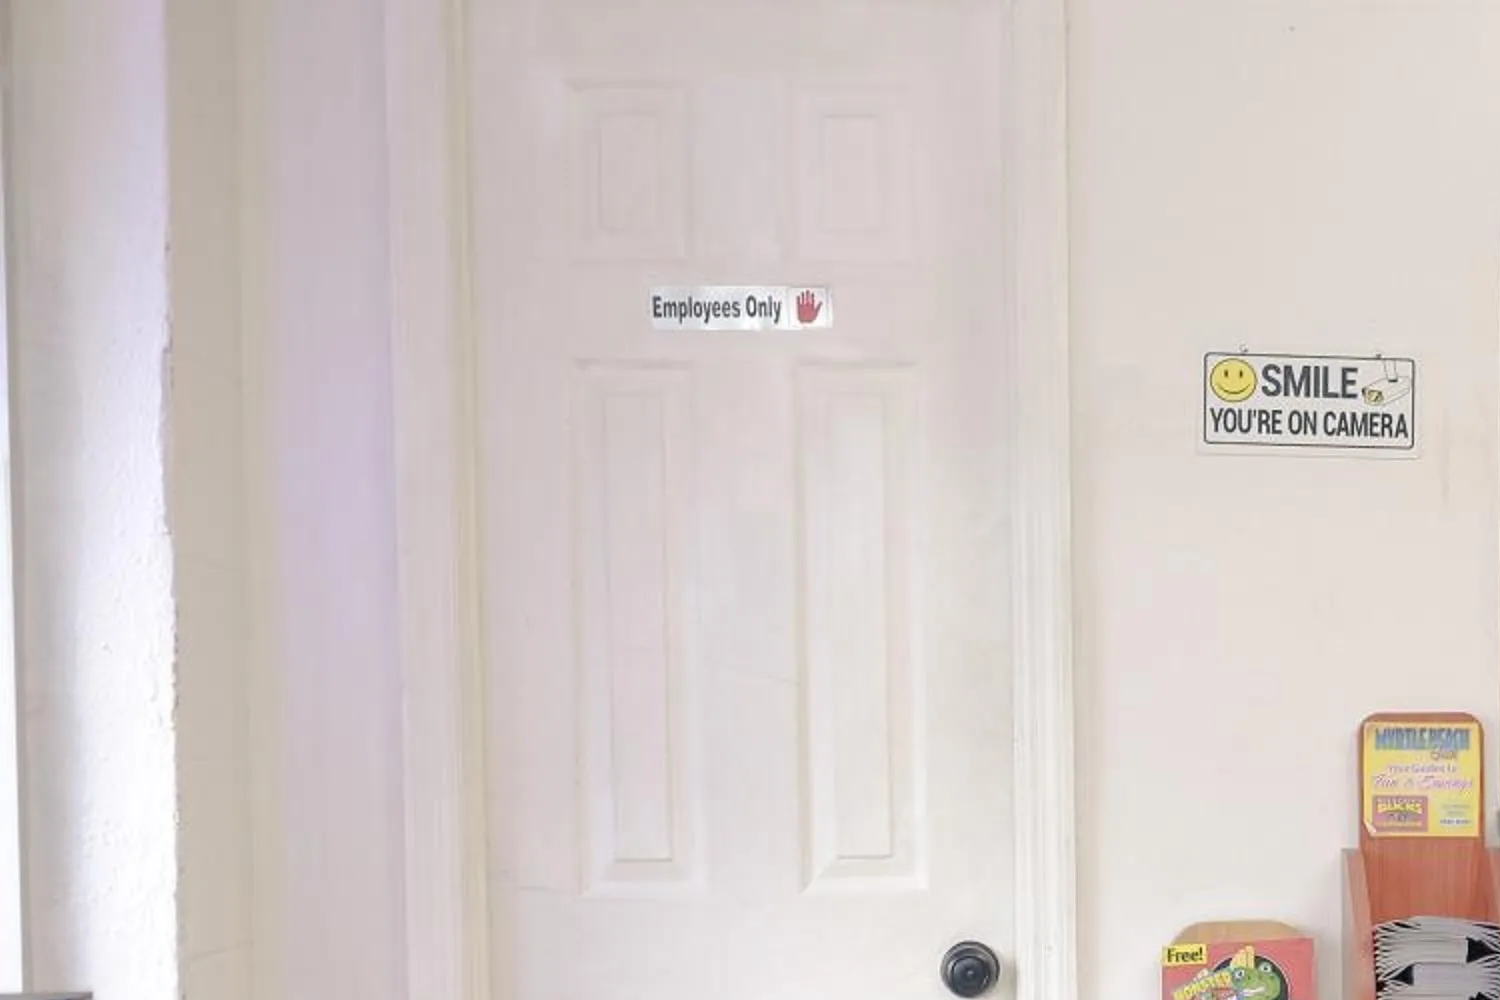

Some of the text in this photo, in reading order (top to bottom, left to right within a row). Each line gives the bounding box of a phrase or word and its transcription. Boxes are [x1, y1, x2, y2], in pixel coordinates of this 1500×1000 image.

[652, 295, 782, 324] Employees Only
[1262, 363, 1359, 399] SMILE
[1210, 407, 1408, 438] YOU'RE ON CAMERA
[1167, 945, 1203, 962] Free!
